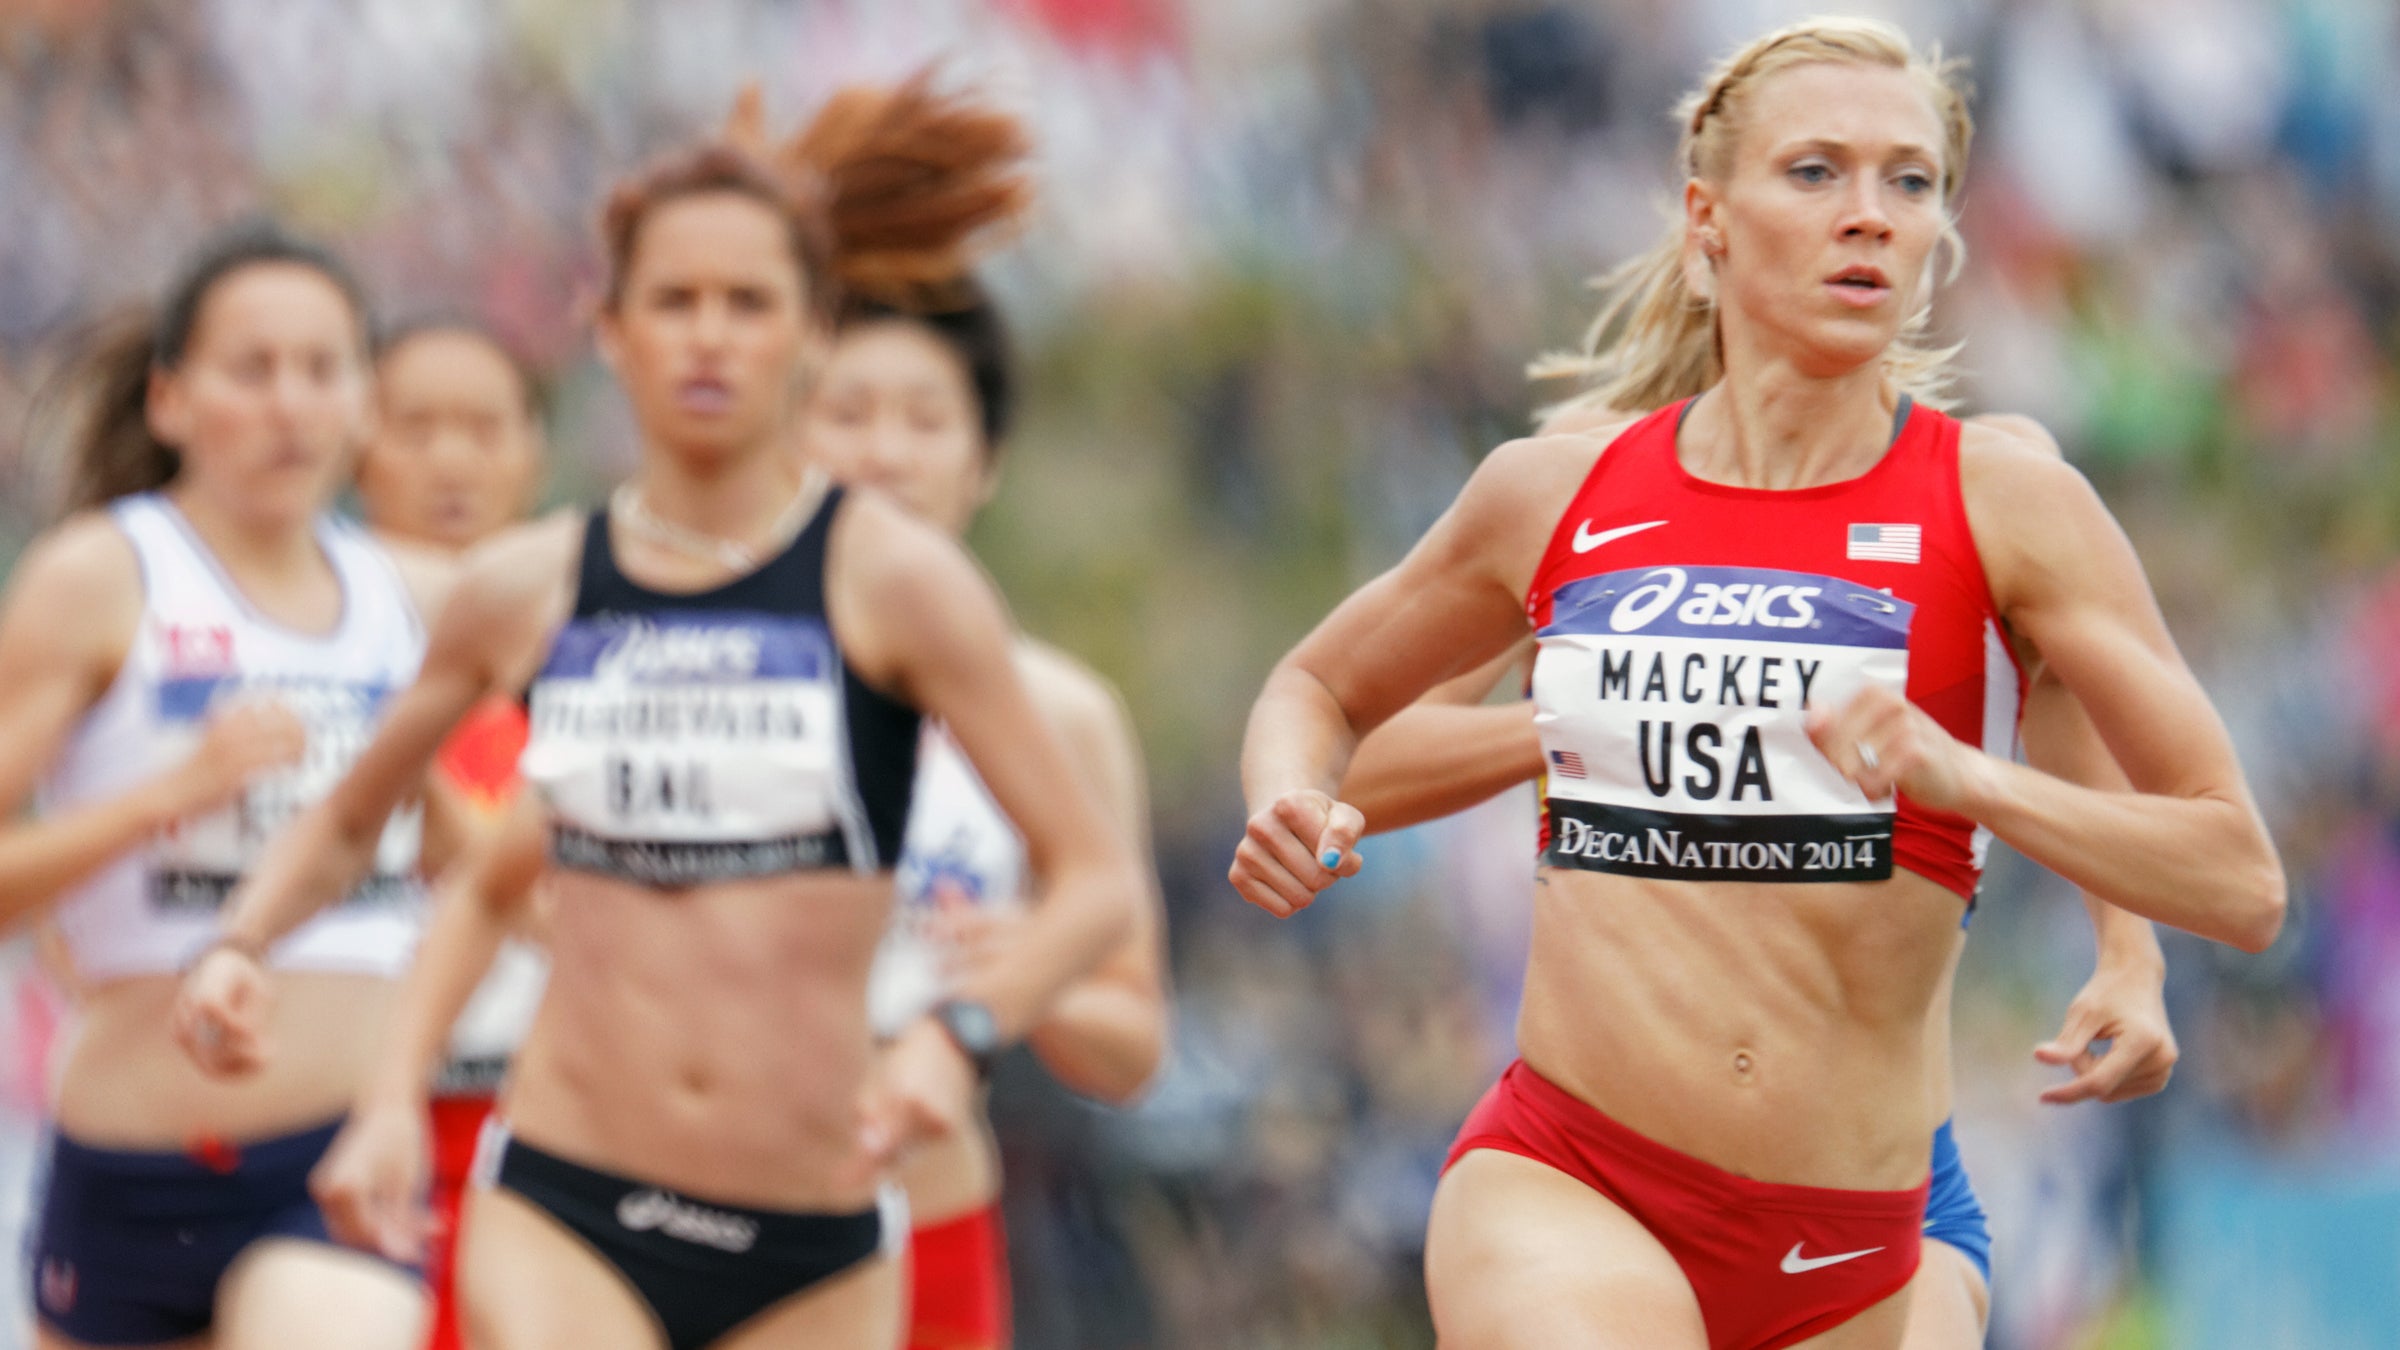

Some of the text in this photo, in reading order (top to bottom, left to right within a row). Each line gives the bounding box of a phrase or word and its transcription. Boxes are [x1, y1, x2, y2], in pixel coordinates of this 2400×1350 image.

[1600, 648, 1823, 712] MACKEY
[1638, 719, 1774, 802] USA
[1802, 840, 1877, 871] 2014
